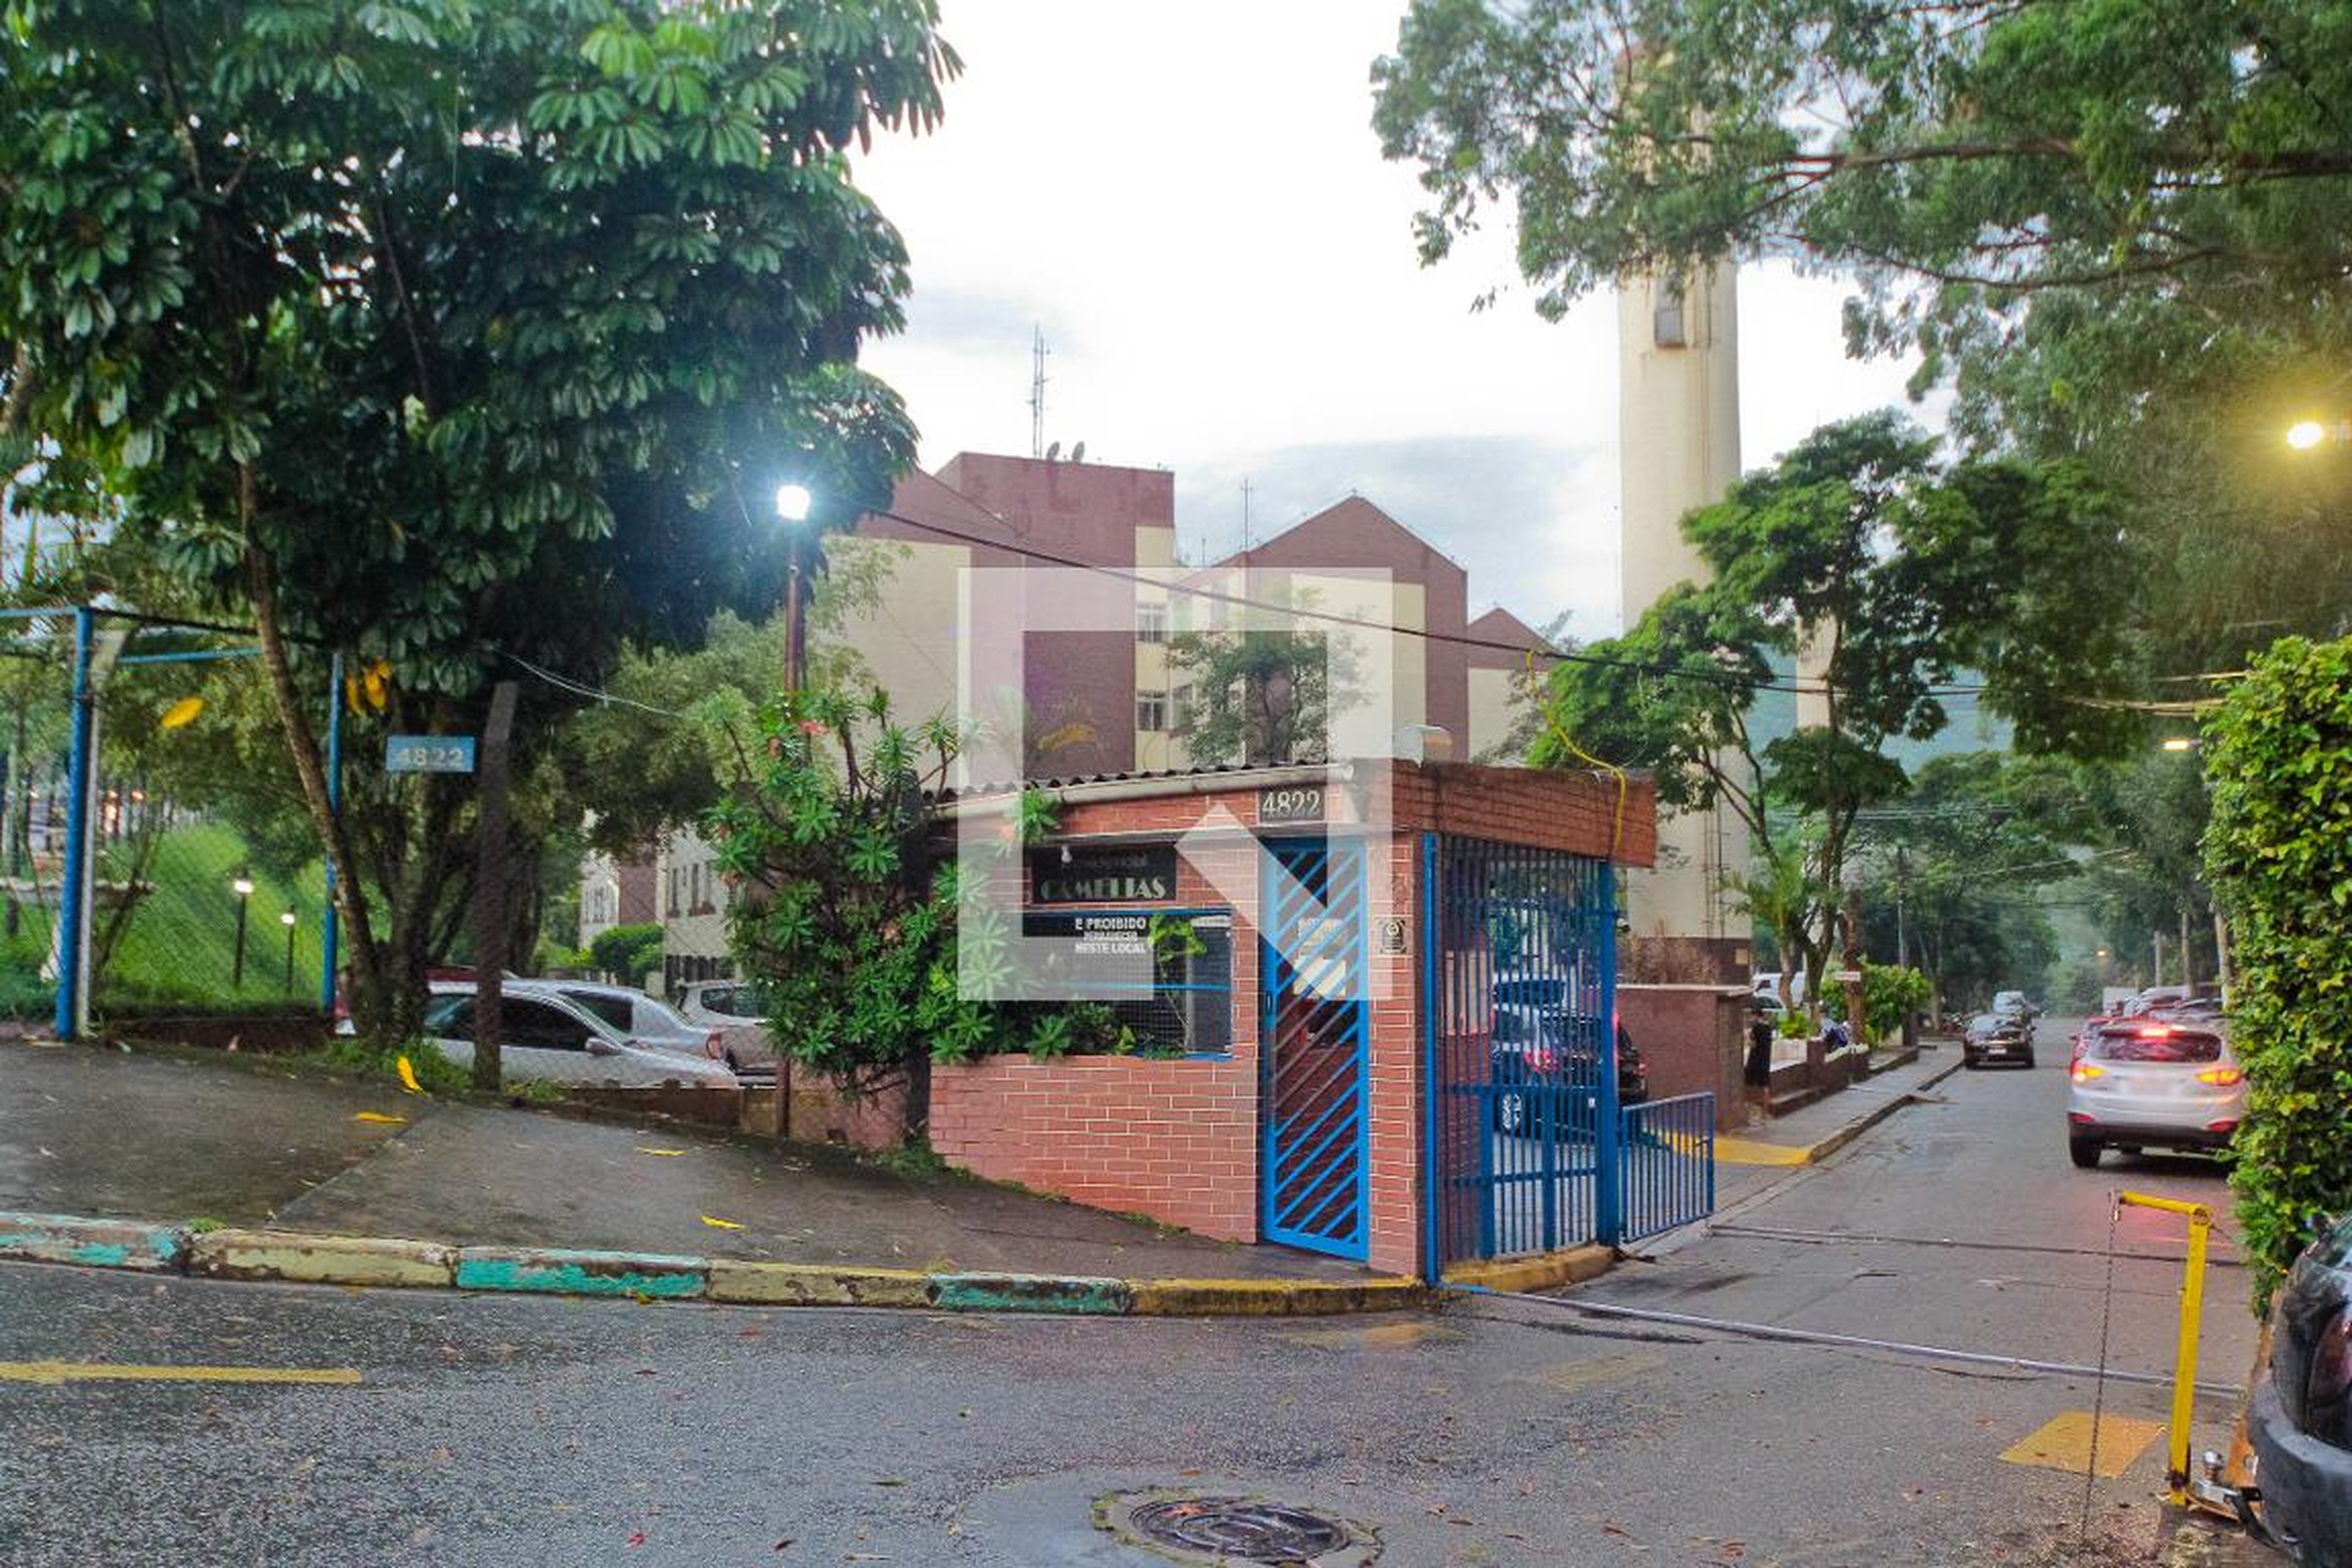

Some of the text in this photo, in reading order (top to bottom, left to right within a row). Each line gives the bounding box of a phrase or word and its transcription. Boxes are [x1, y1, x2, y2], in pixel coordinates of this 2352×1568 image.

[1262, 790, 1320, 819] 4822
[1085, 917, 1147, 930] PROIBIDO
[1075, 942, 1147, 954] NESTE LOCAL
